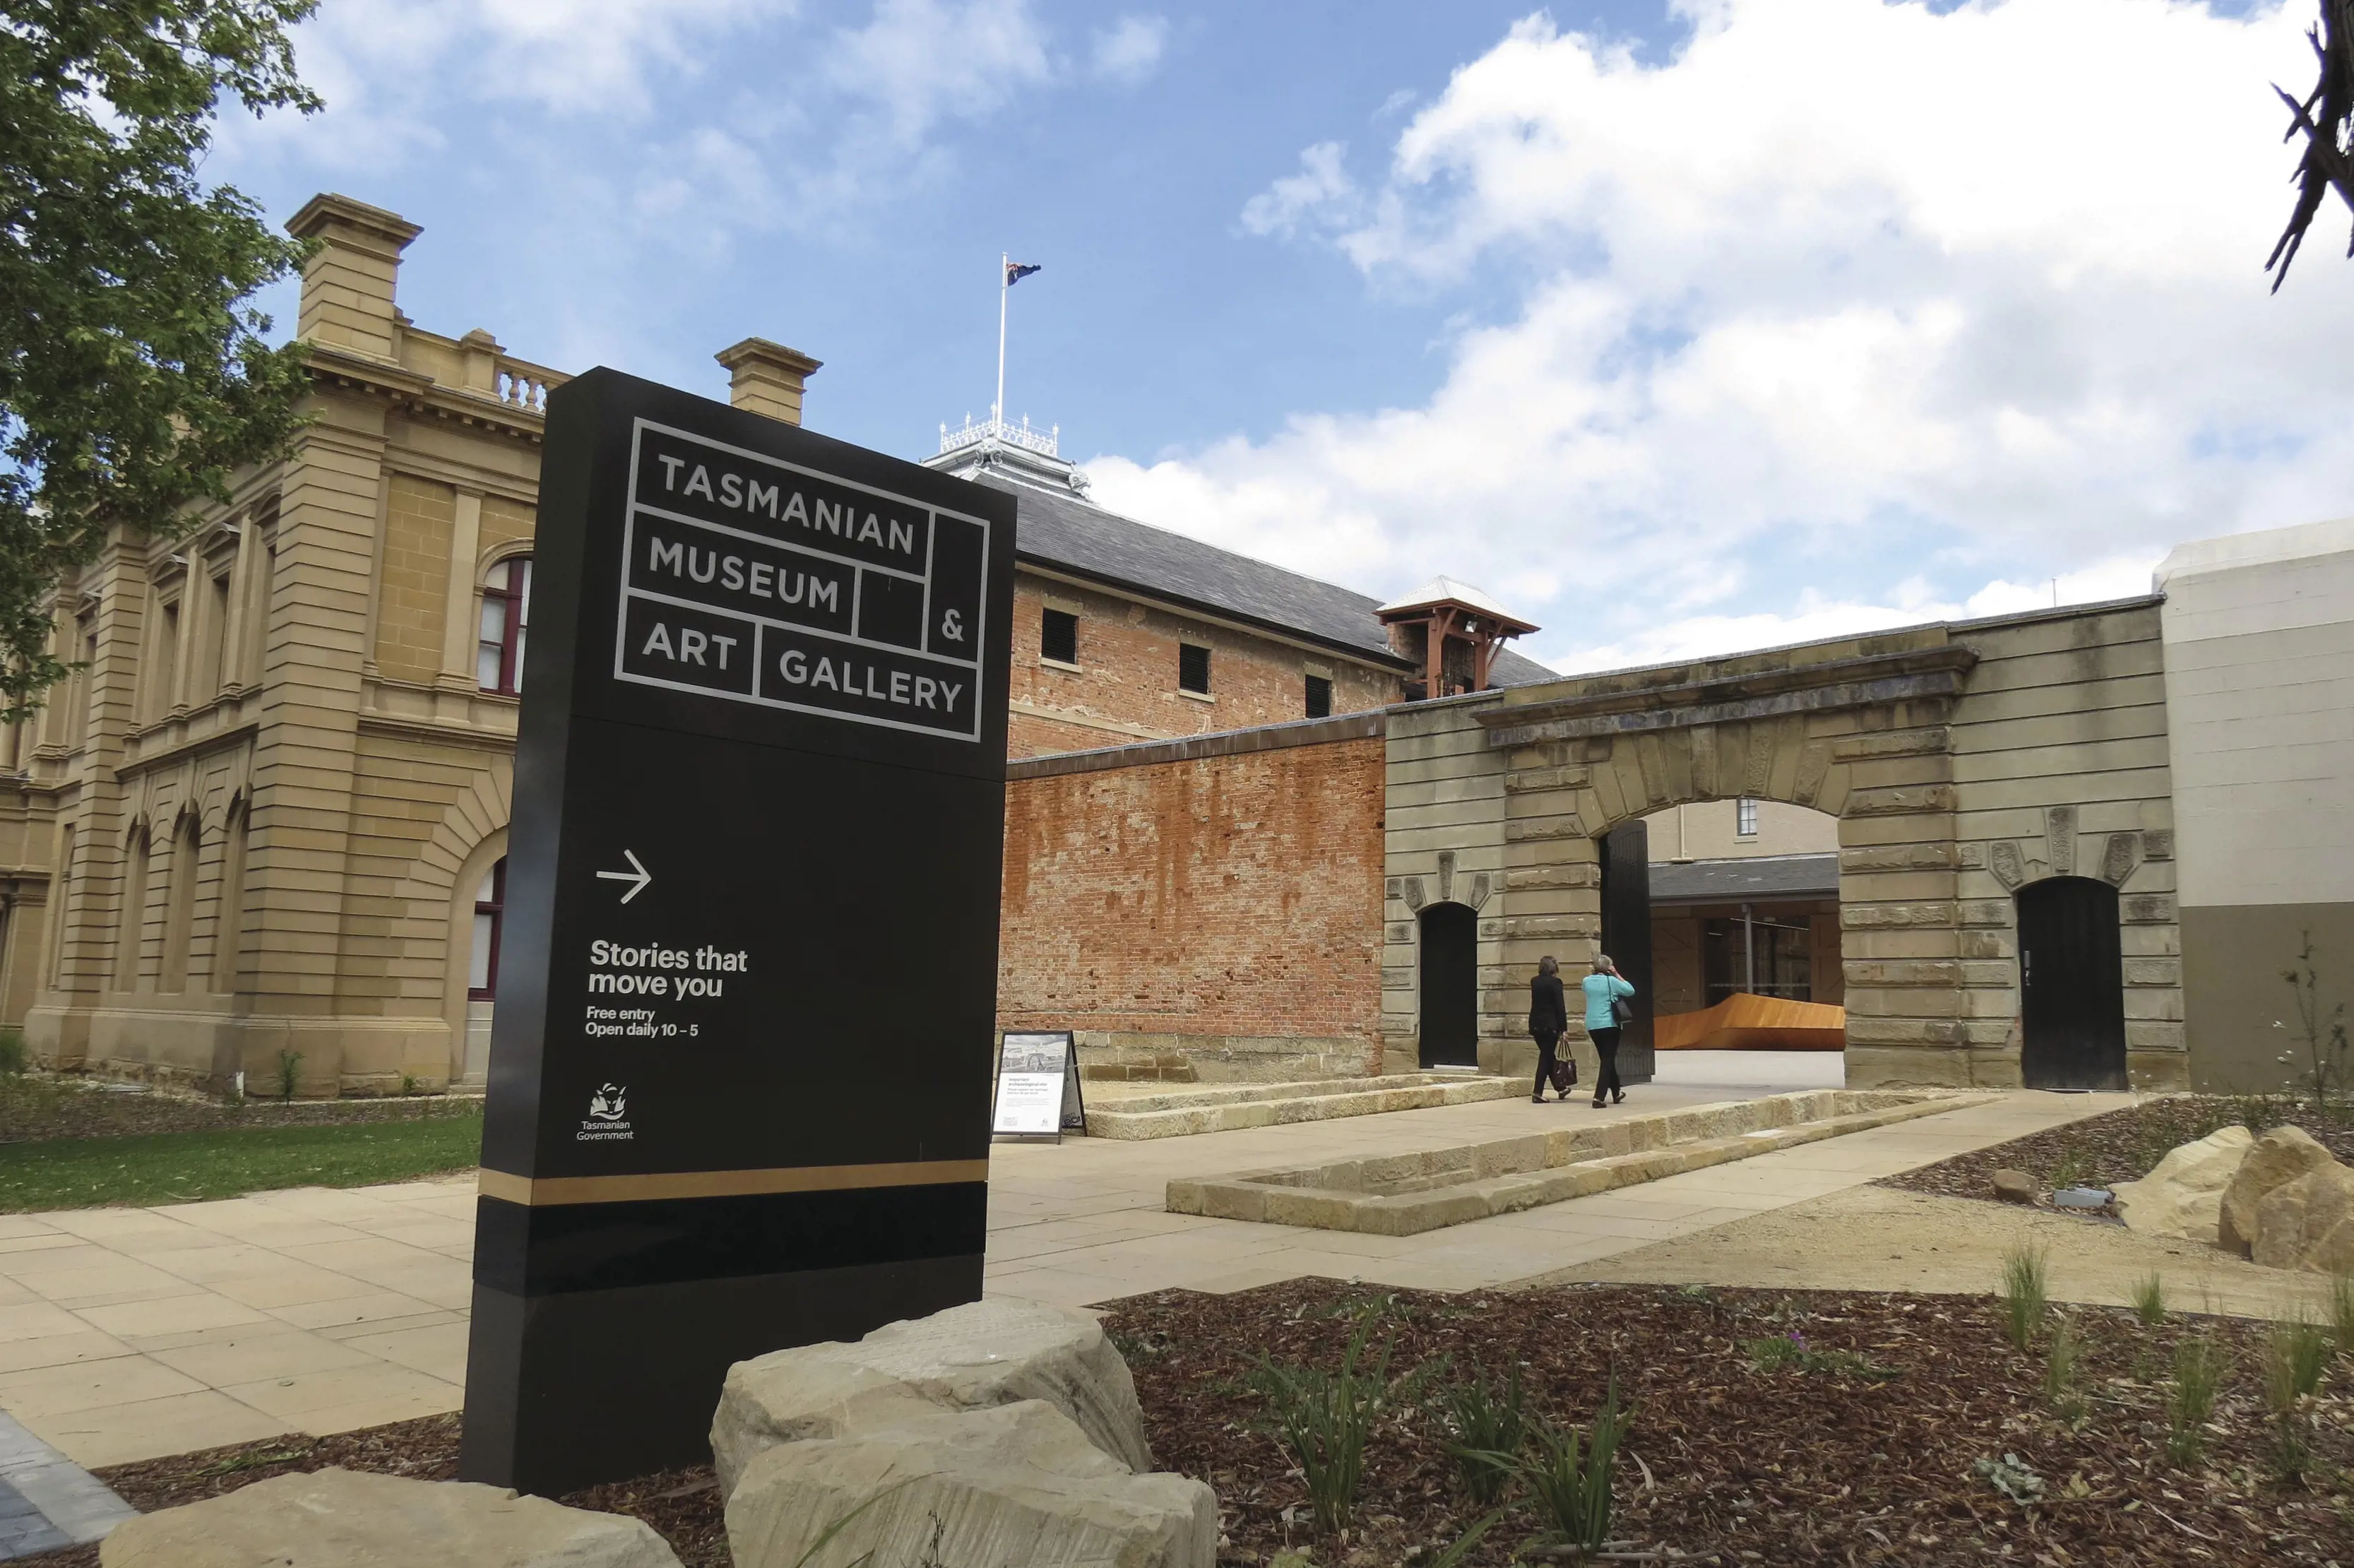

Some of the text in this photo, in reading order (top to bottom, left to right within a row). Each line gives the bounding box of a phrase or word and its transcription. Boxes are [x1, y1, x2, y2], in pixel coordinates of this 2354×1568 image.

[658, 453, 913, 554] TASMANIAN
[650, 537, 838, 613] MUSEUM
[941, 608, 964, 641] &
[642, 622, 963, 713] ART GALLERY
[590, 939, 749, 973] Stories that
[588, 973, 723, 1002] move you
[585, 1021, 624, 1038] Open
[626, 1022, 659, 1038] daily
[660, 1023, 677, 1036] 10
[689, 1023, 699, 1037] 5
[586, 1005, 655, 1023] Free entry
[576, 1130, 634, 1141] Government
[581, 1119, 631, 1130] Tasmanian
